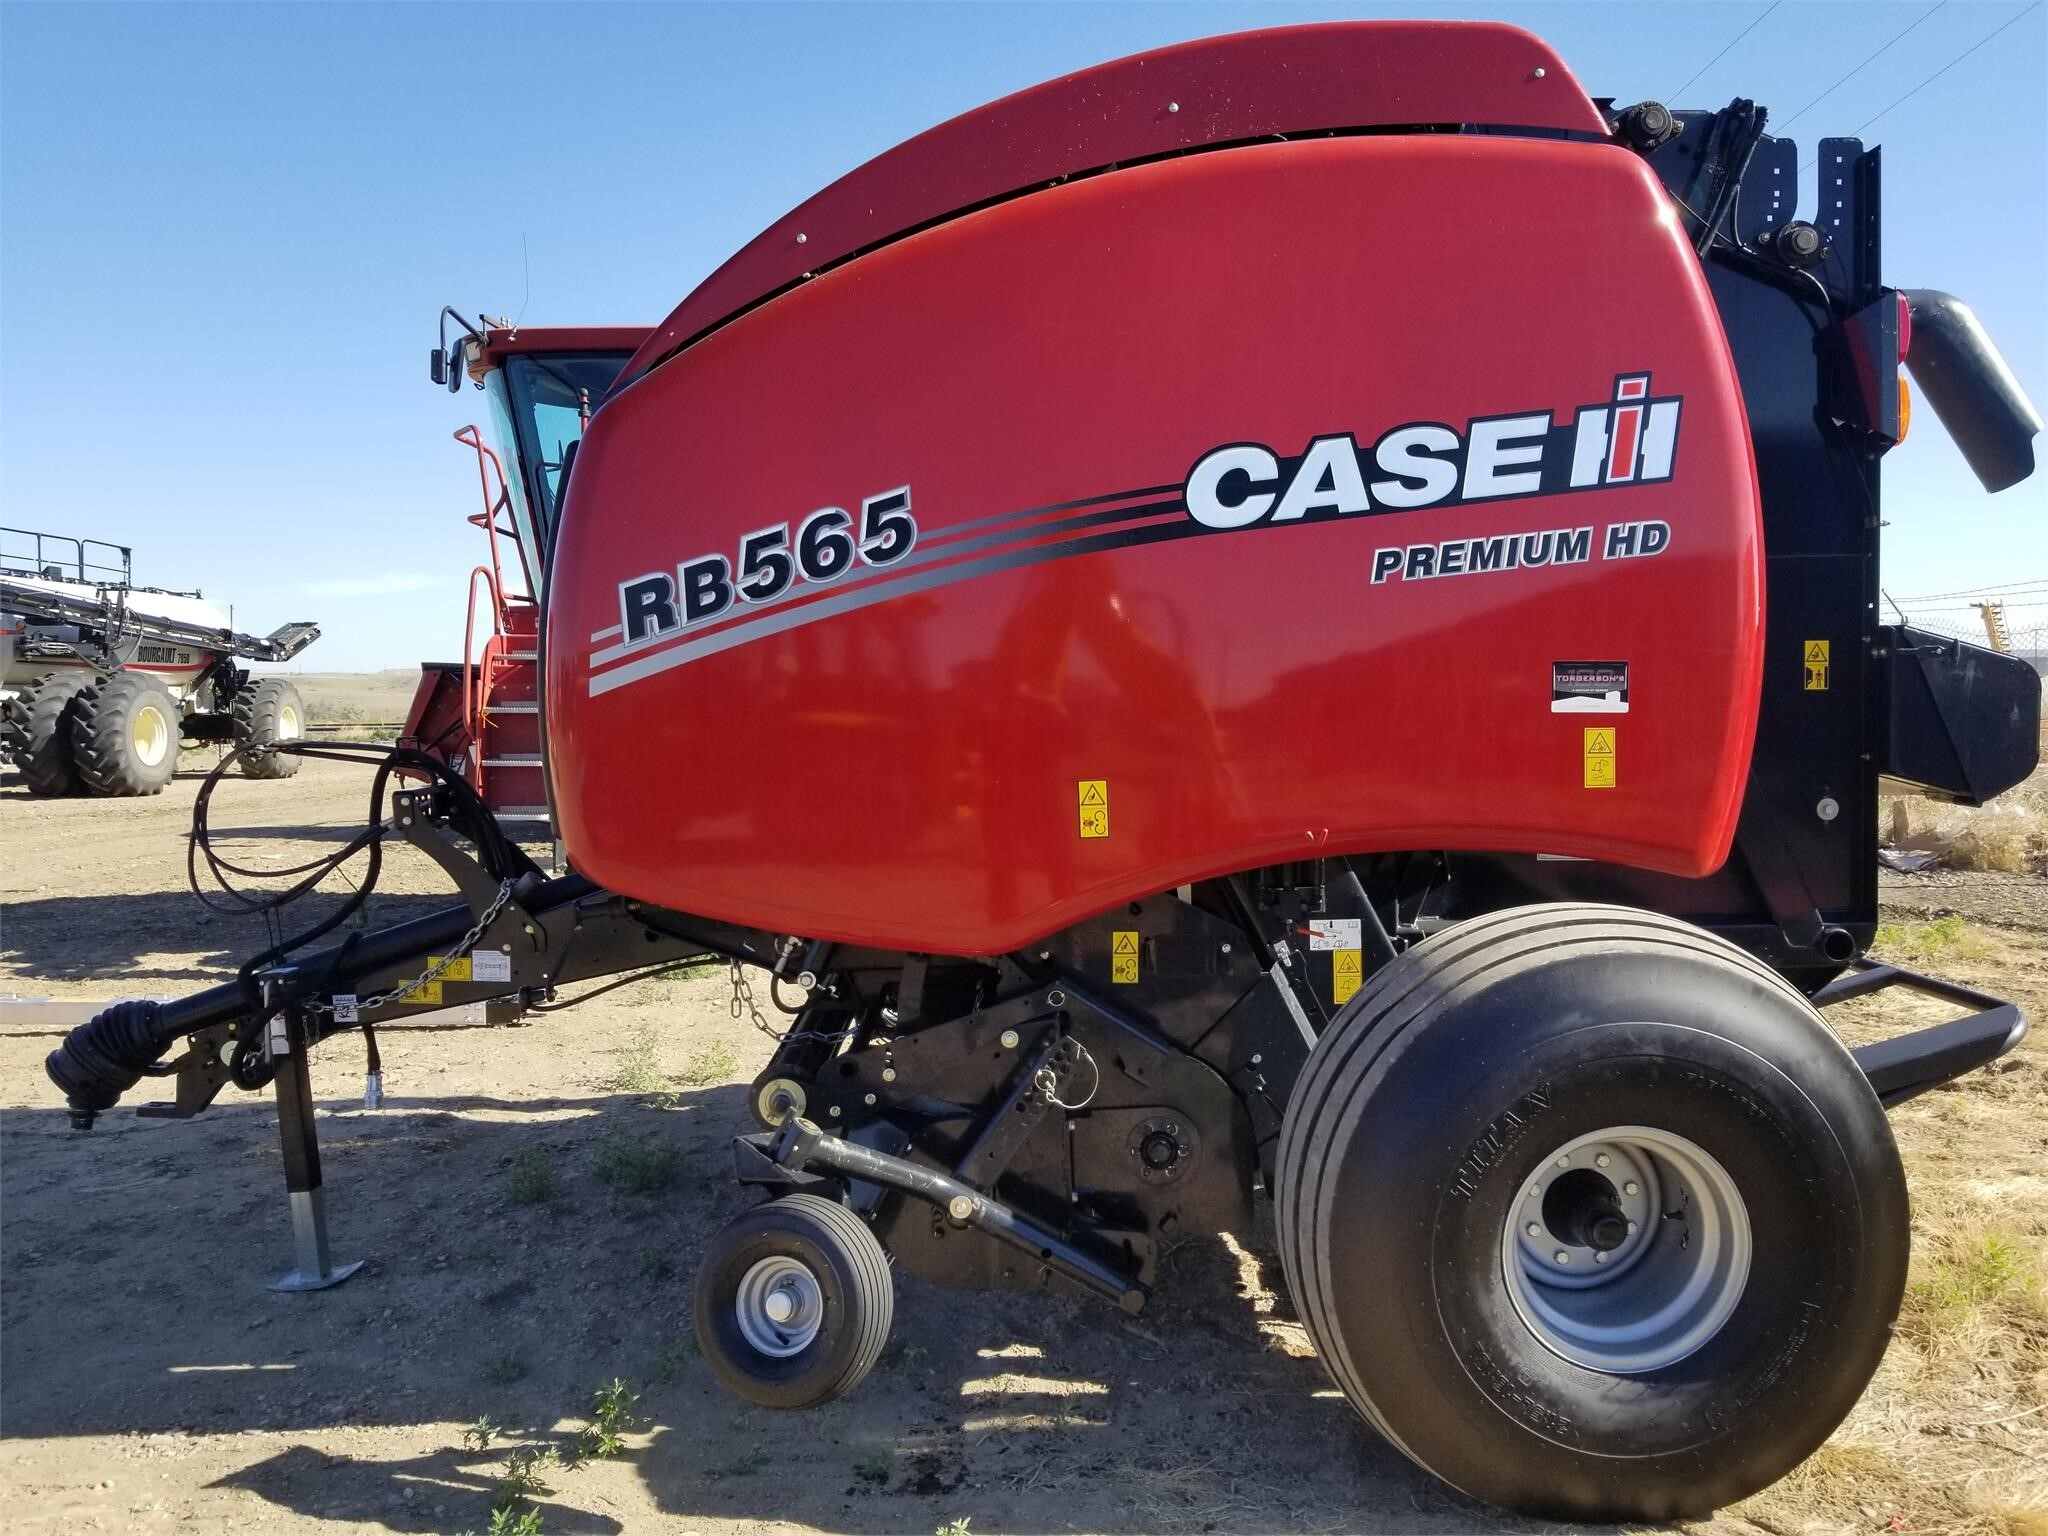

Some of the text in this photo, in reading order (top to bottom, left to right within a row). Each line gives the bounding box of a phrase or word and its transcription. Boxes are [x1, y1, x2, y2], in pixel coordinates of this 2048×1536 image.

[1185, 413, 1552, 528] CASE
[618, 485, 918, 648] RB565
[1370, 519, 1672, 584] PREMIUM HD
[138, 645, 176, 663] BOURGAULT
[1450, 1082, 1553, 1202] TITAN
